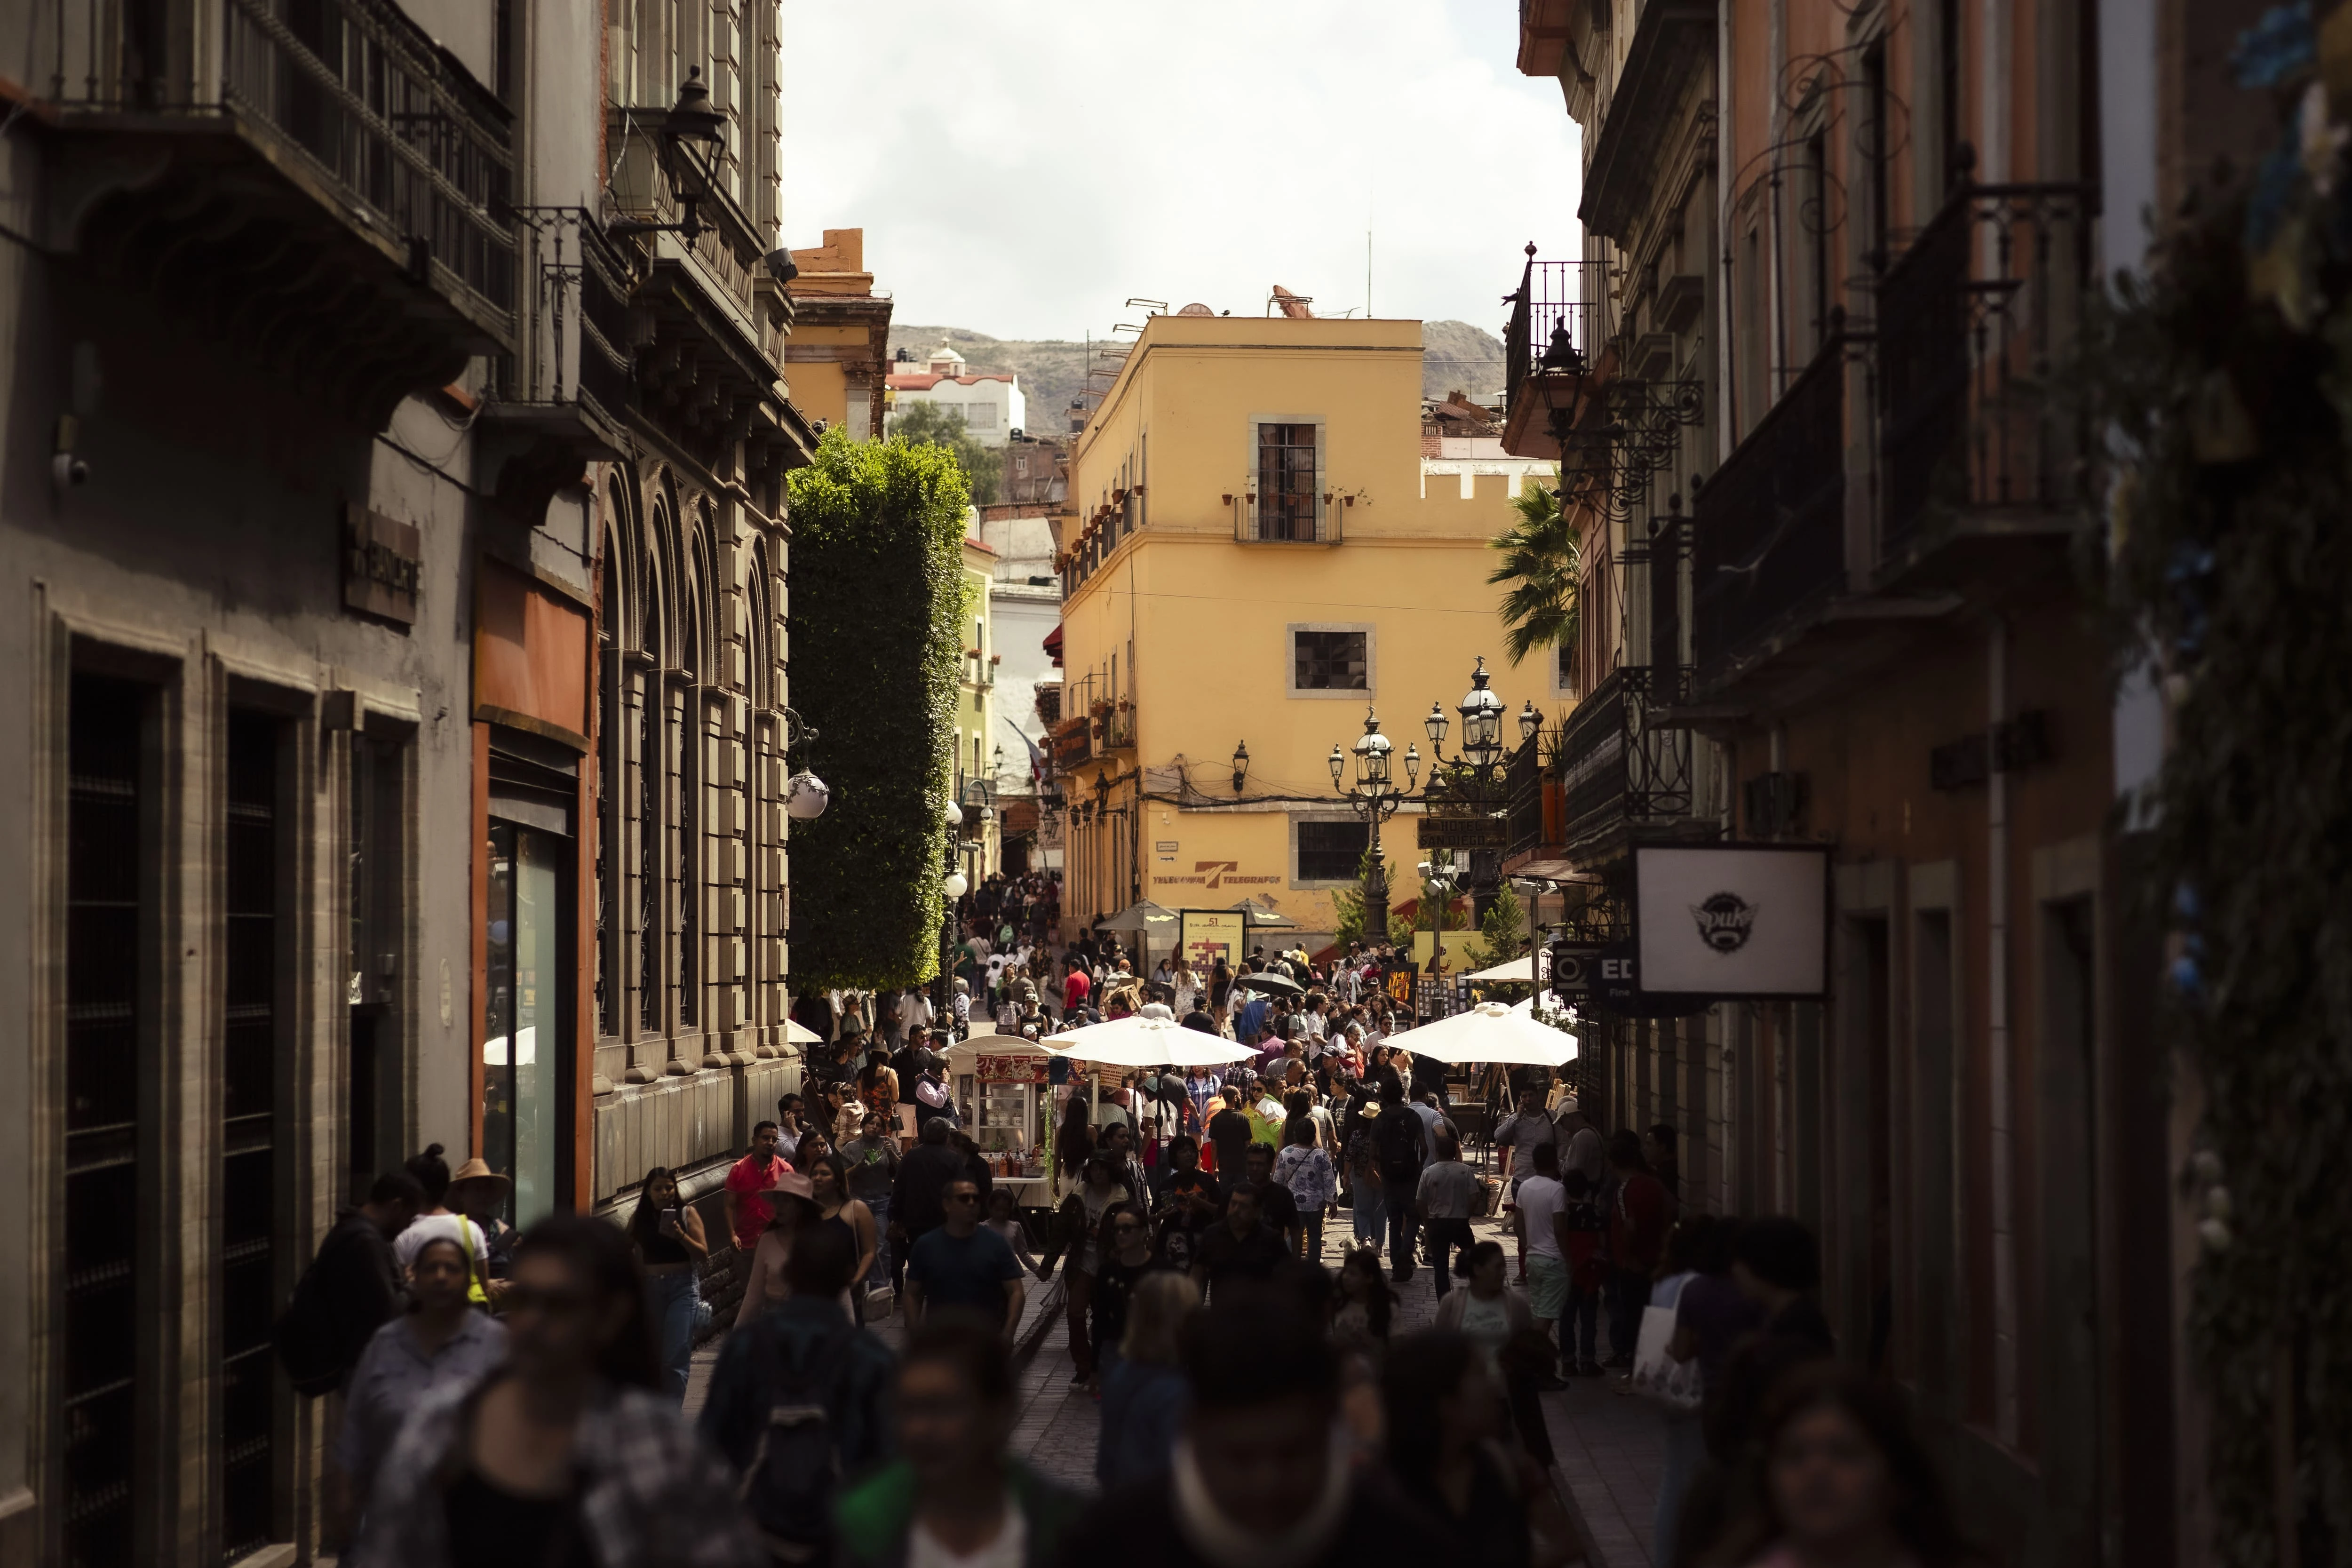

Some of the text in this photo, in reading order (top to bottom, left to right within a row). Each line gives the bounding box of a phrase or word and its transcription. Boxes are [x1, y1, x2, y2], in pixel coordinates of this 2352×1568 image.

[1441, 821, 1483, 832] HOTEL
[1420, 836, 1486, 846] SAN DIEGO
[1609, 988, 1630, 997] Fine
